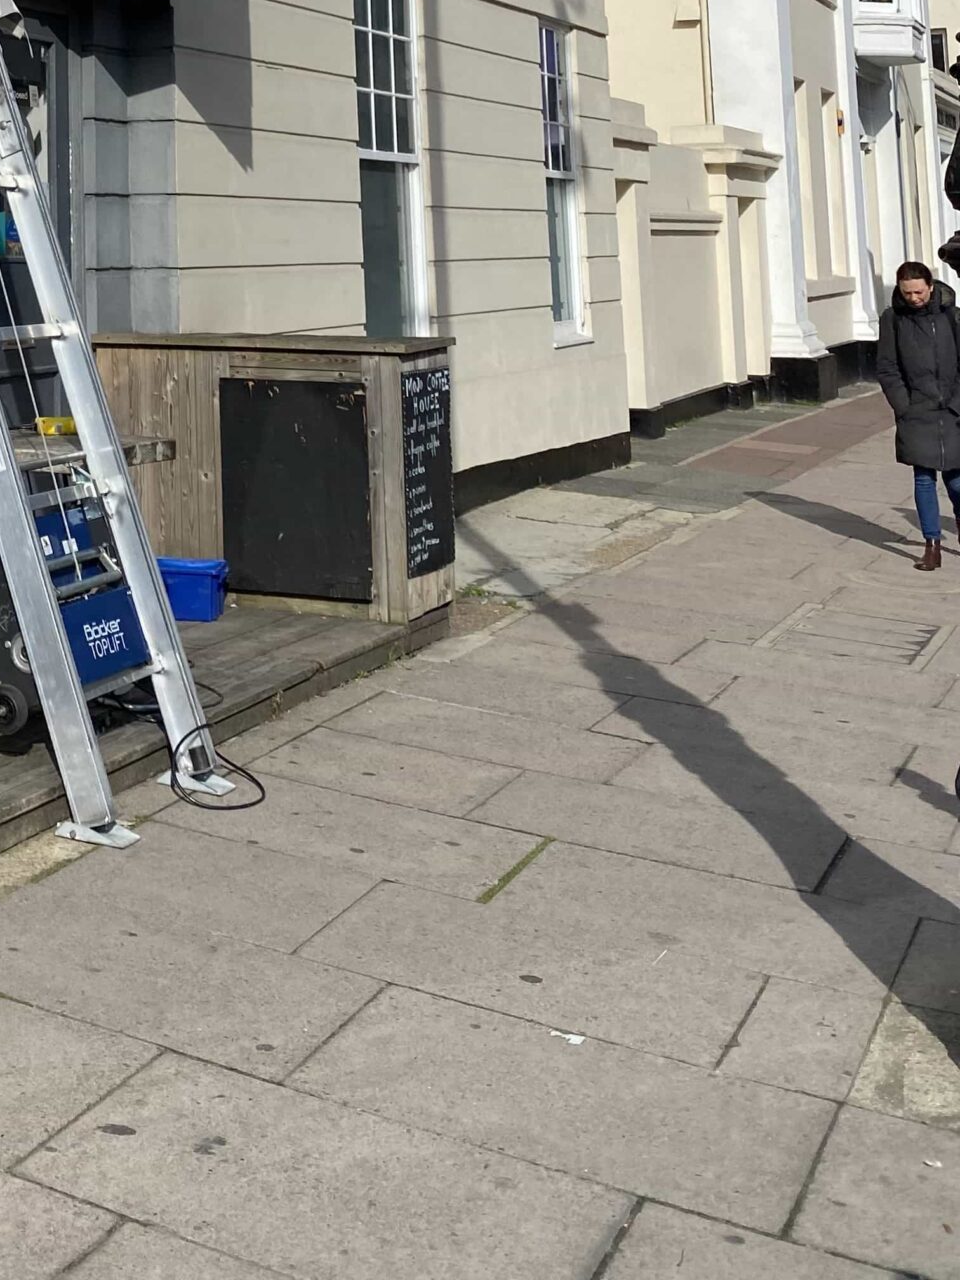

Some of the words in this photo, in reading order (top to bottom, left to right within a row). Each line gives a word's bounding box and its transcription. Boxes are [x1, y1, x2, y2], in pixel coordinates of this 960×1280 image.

[427, 369, 450, 391] COFFEE
[413, 392, 440, 416] HOUSE
[83, 618, 121, 641] Böcker
[88, 632, 127, 660] TOPLIFT
